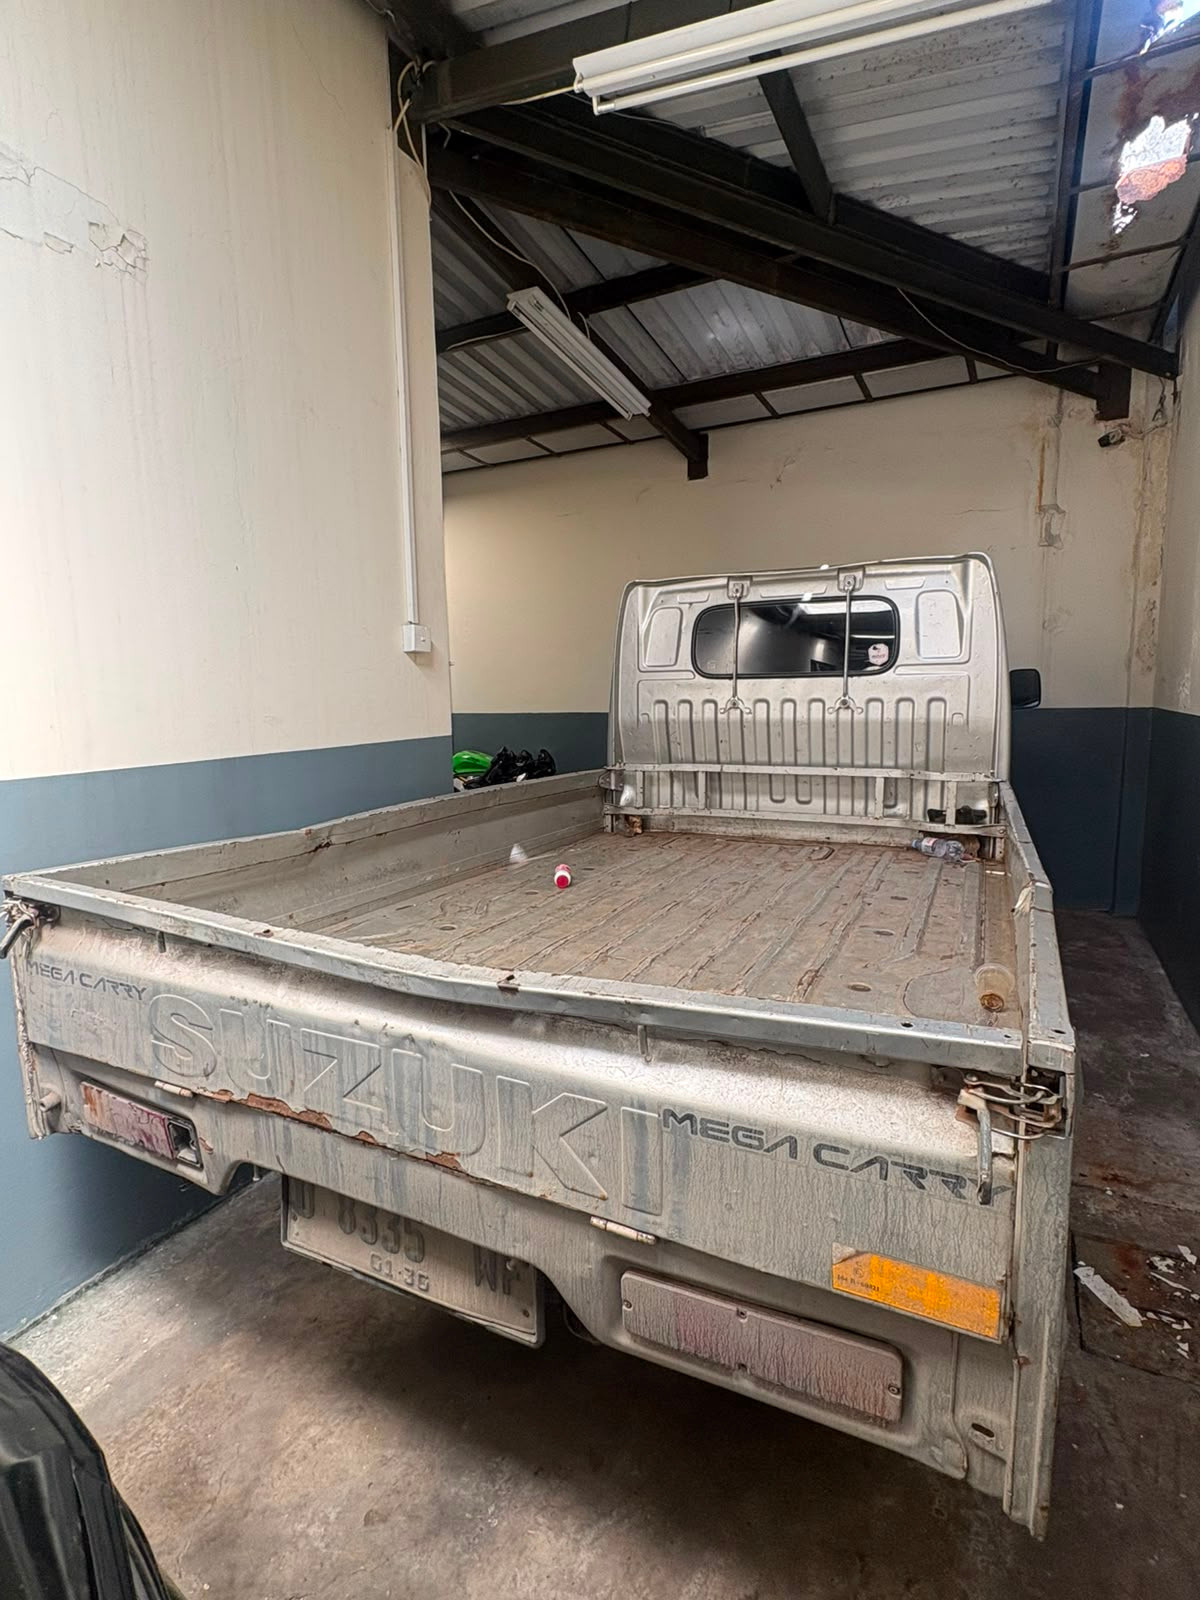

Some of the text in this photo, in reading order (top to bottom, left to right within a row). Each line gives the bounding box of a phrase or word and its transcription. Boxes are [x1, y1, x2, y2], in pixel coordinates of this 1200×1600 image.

[25, 959, 147, 1001] MEGA CARRY
[149, 993, 664, 1217] SUZUKI
[662, 1108, 798, 1160] MEGA
